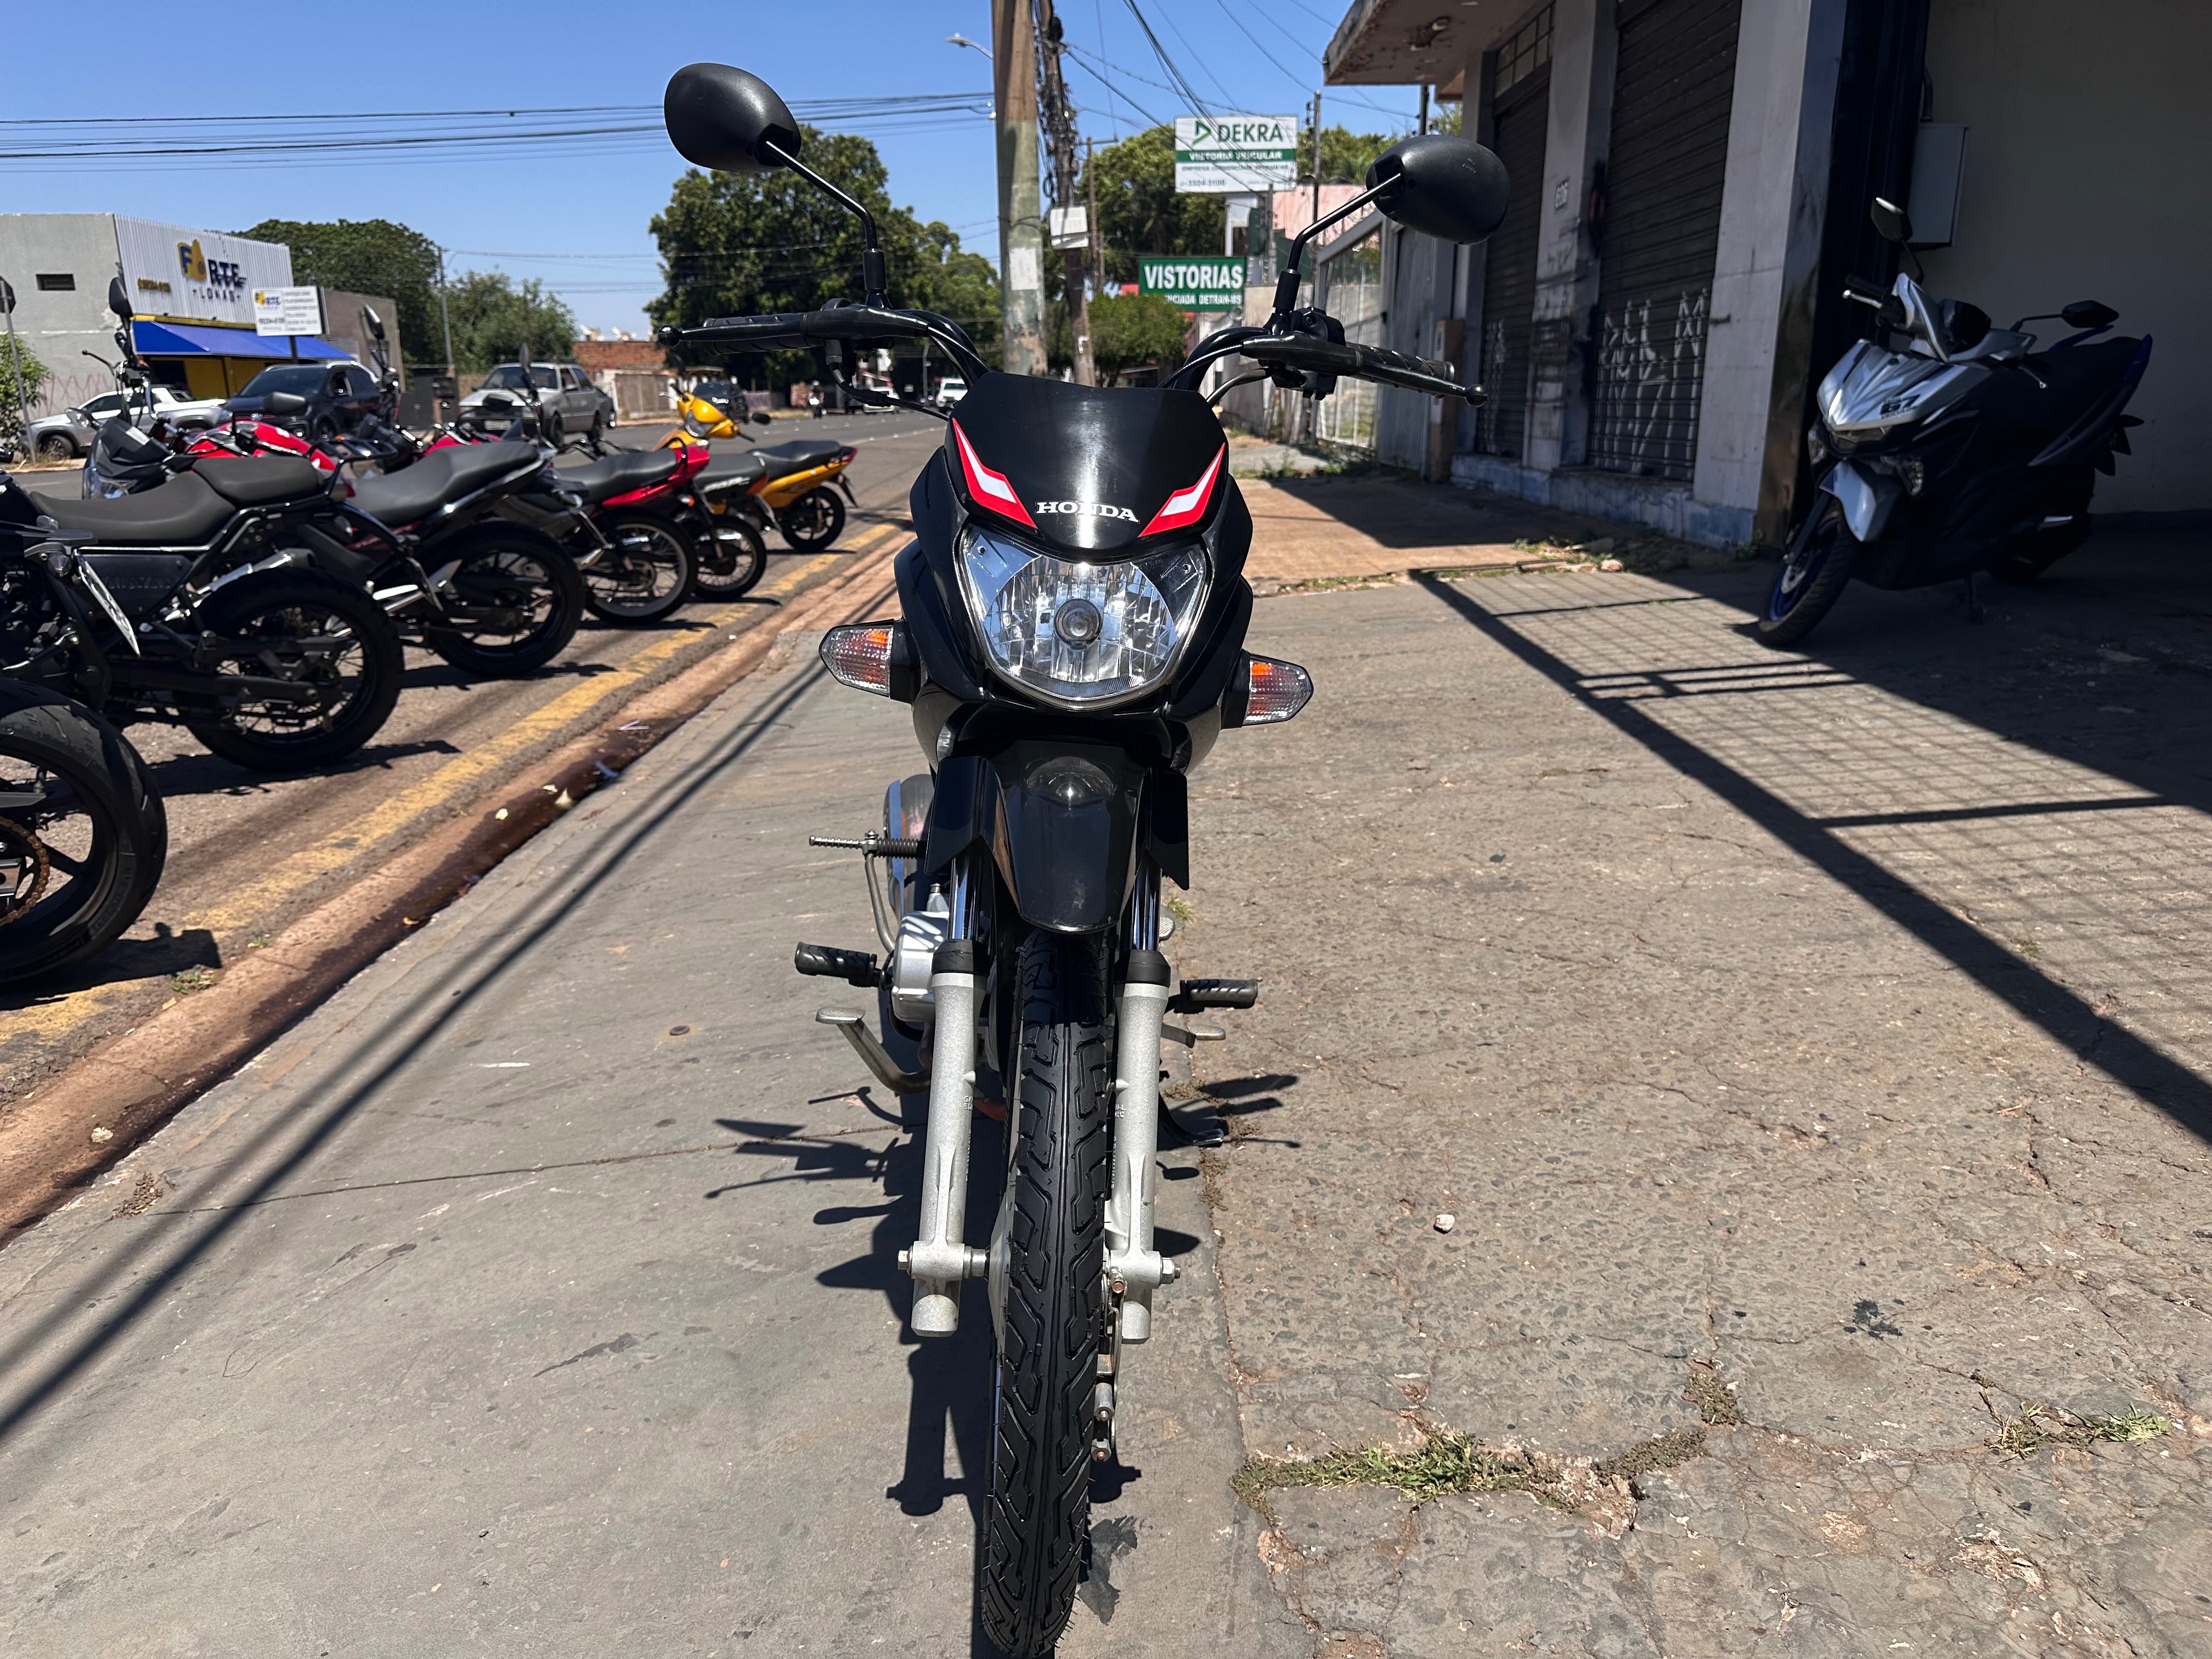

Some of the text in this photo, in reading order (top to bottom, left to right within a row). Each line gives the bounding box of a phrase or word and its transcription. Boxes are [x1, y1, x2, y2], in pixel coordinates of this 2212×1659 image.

[1217, 123, 1283, 142] DEKRA
[1189, 151, 1233, 161] VISTORIA
[1144, 264, 1244, 289] VISTORIAS
[1165, 294, 1196, 304] NCIADA
[1036, 501, 1139, 523] HONDA
